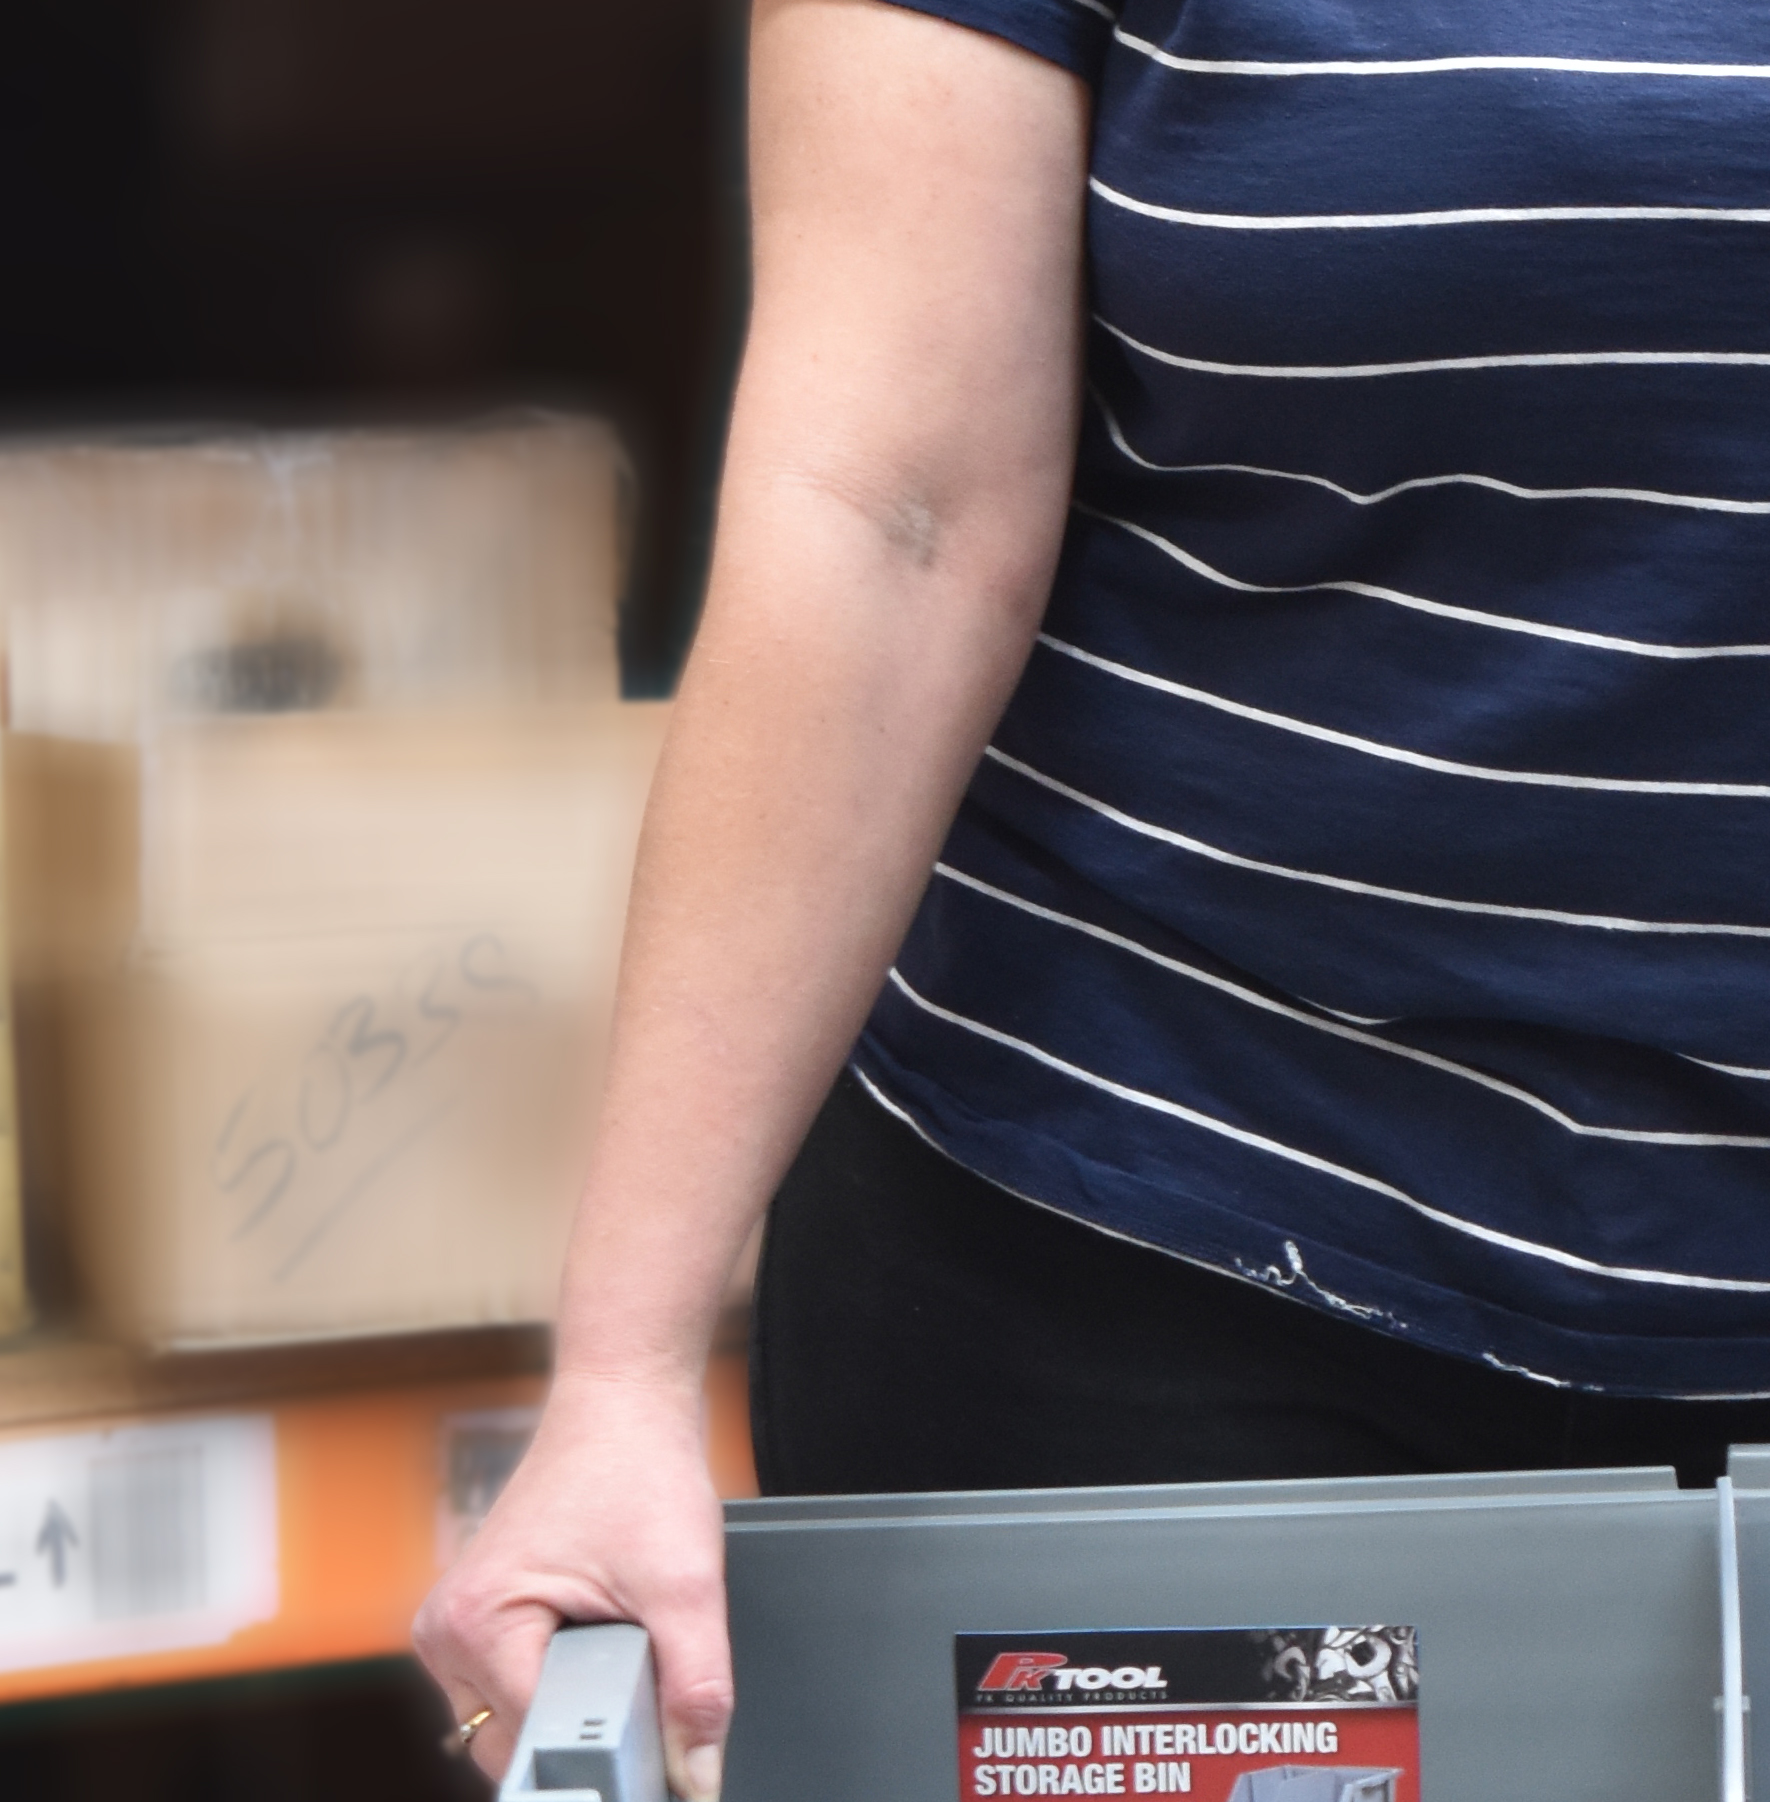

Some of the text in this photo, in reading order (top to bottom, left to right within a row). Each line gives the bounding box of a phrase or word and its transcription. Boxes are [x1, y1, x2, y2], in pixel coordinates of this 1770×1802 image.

[1054, 1666, 1168, 1690] TOOL
[1006, 1692, 1073, 1702] QUALITY
[1084, 1690, 1168, 1701] PRODUCTS
[974, 1721, 1338, 1758] JUMBO INTERLOCKING
[974, 1761, 1191, 1796] STORAGE BIN
